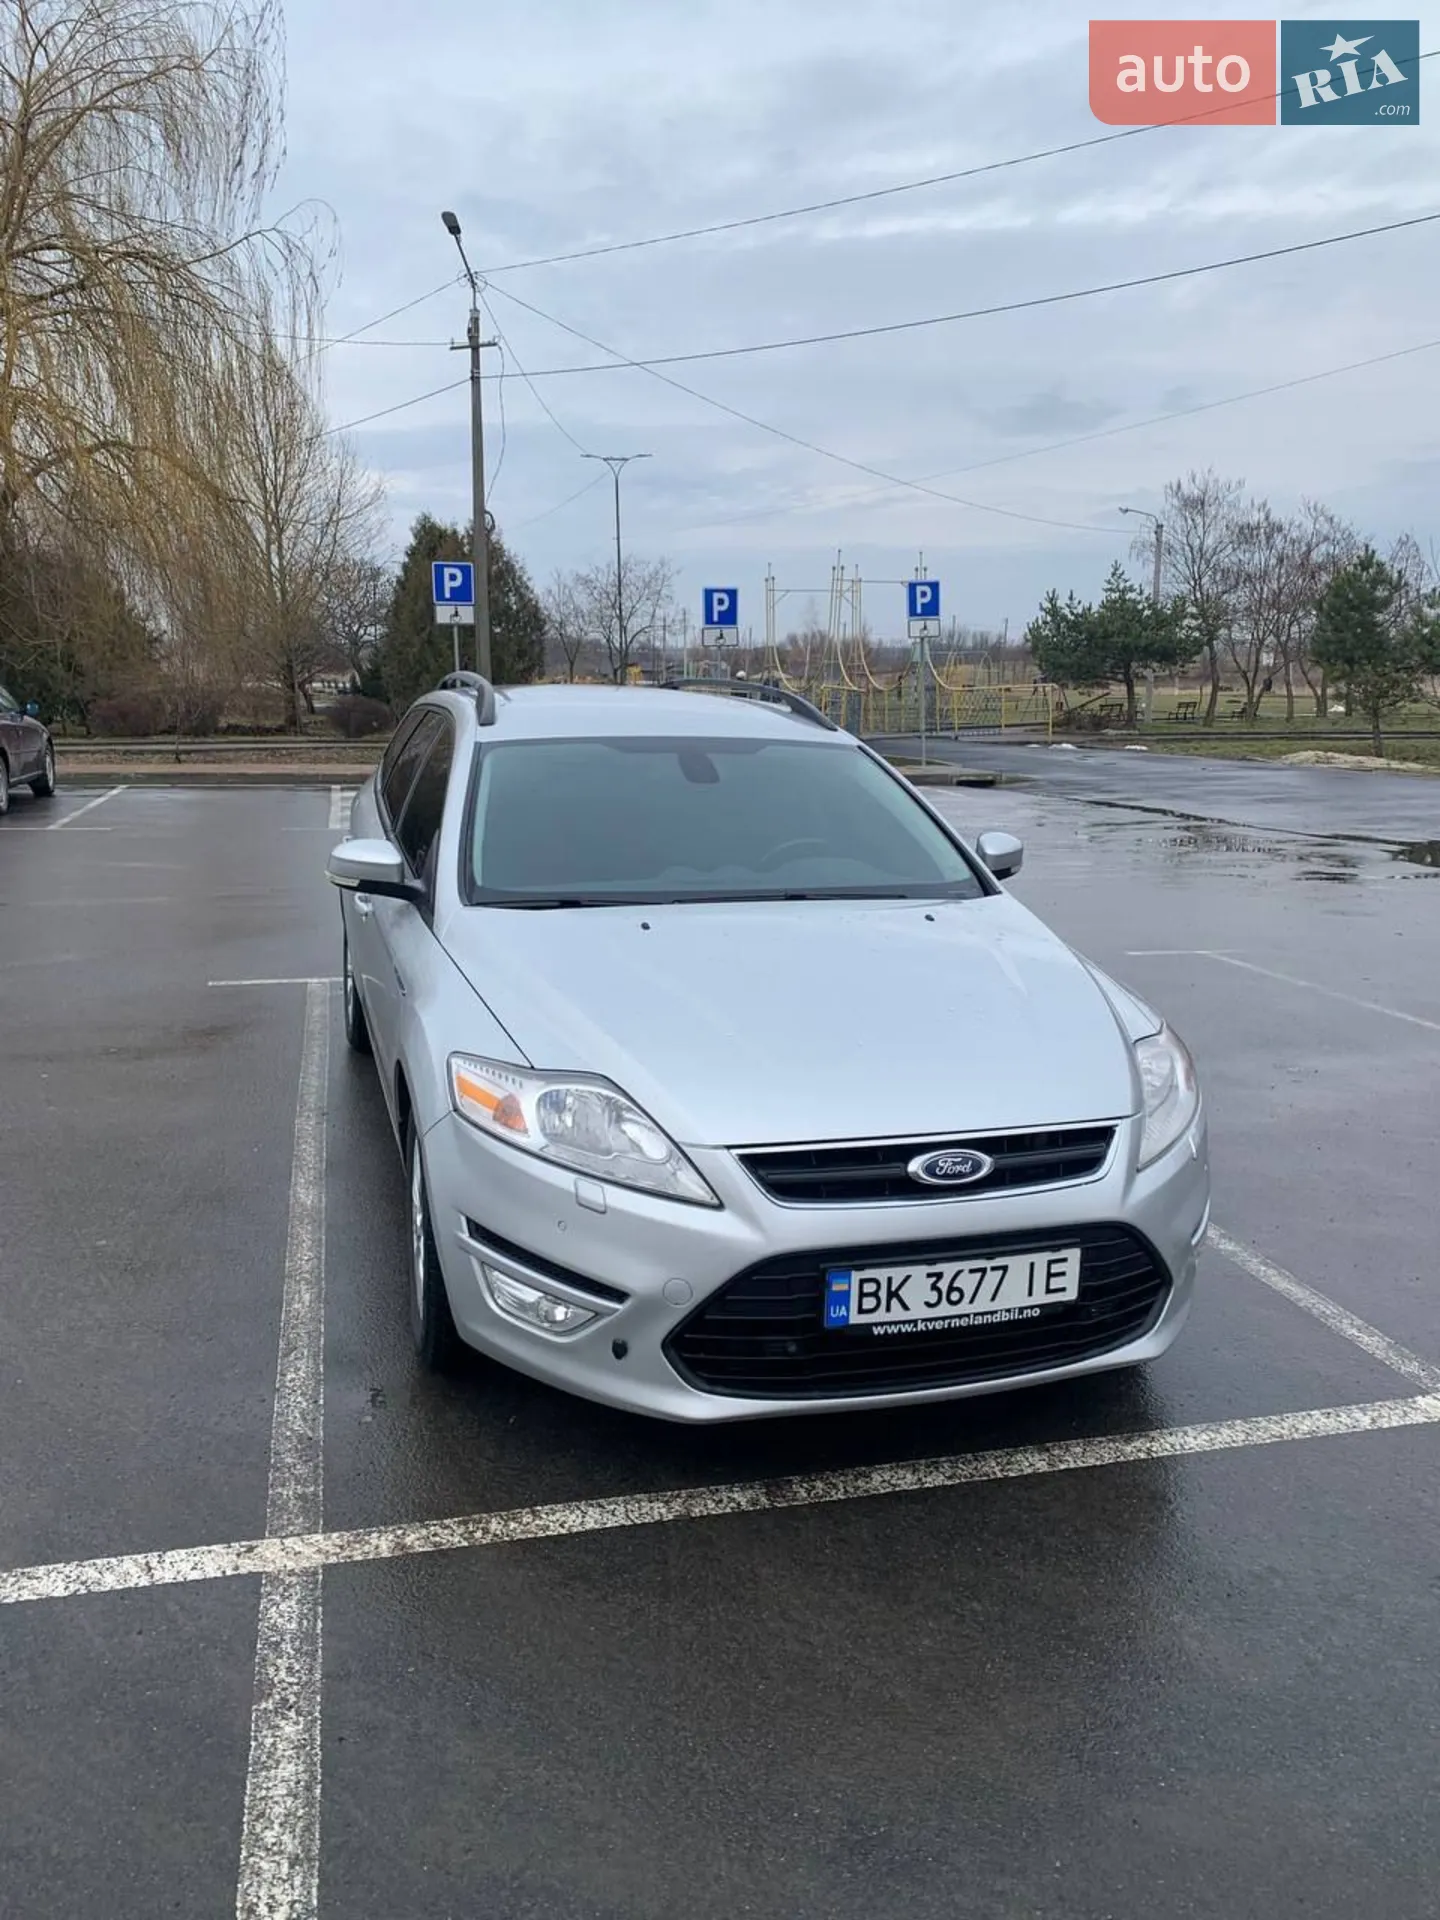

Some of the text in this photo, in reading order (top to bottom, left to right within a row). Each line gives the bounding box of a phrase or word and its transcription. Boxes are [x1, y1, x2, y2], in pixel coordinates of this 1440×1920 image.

[443, 567, 463, 599] P
[712, 592, 730, 622] P
[916, 585, 932, 614] P
[935, 1156, 972, 1176] Ford
[856, 1257, 1069, 1315] BK 3677 IE
[830, 1304, 848, 1319] UA
[872, 1306, 1040, 1336] www.kvernelandbil.no
